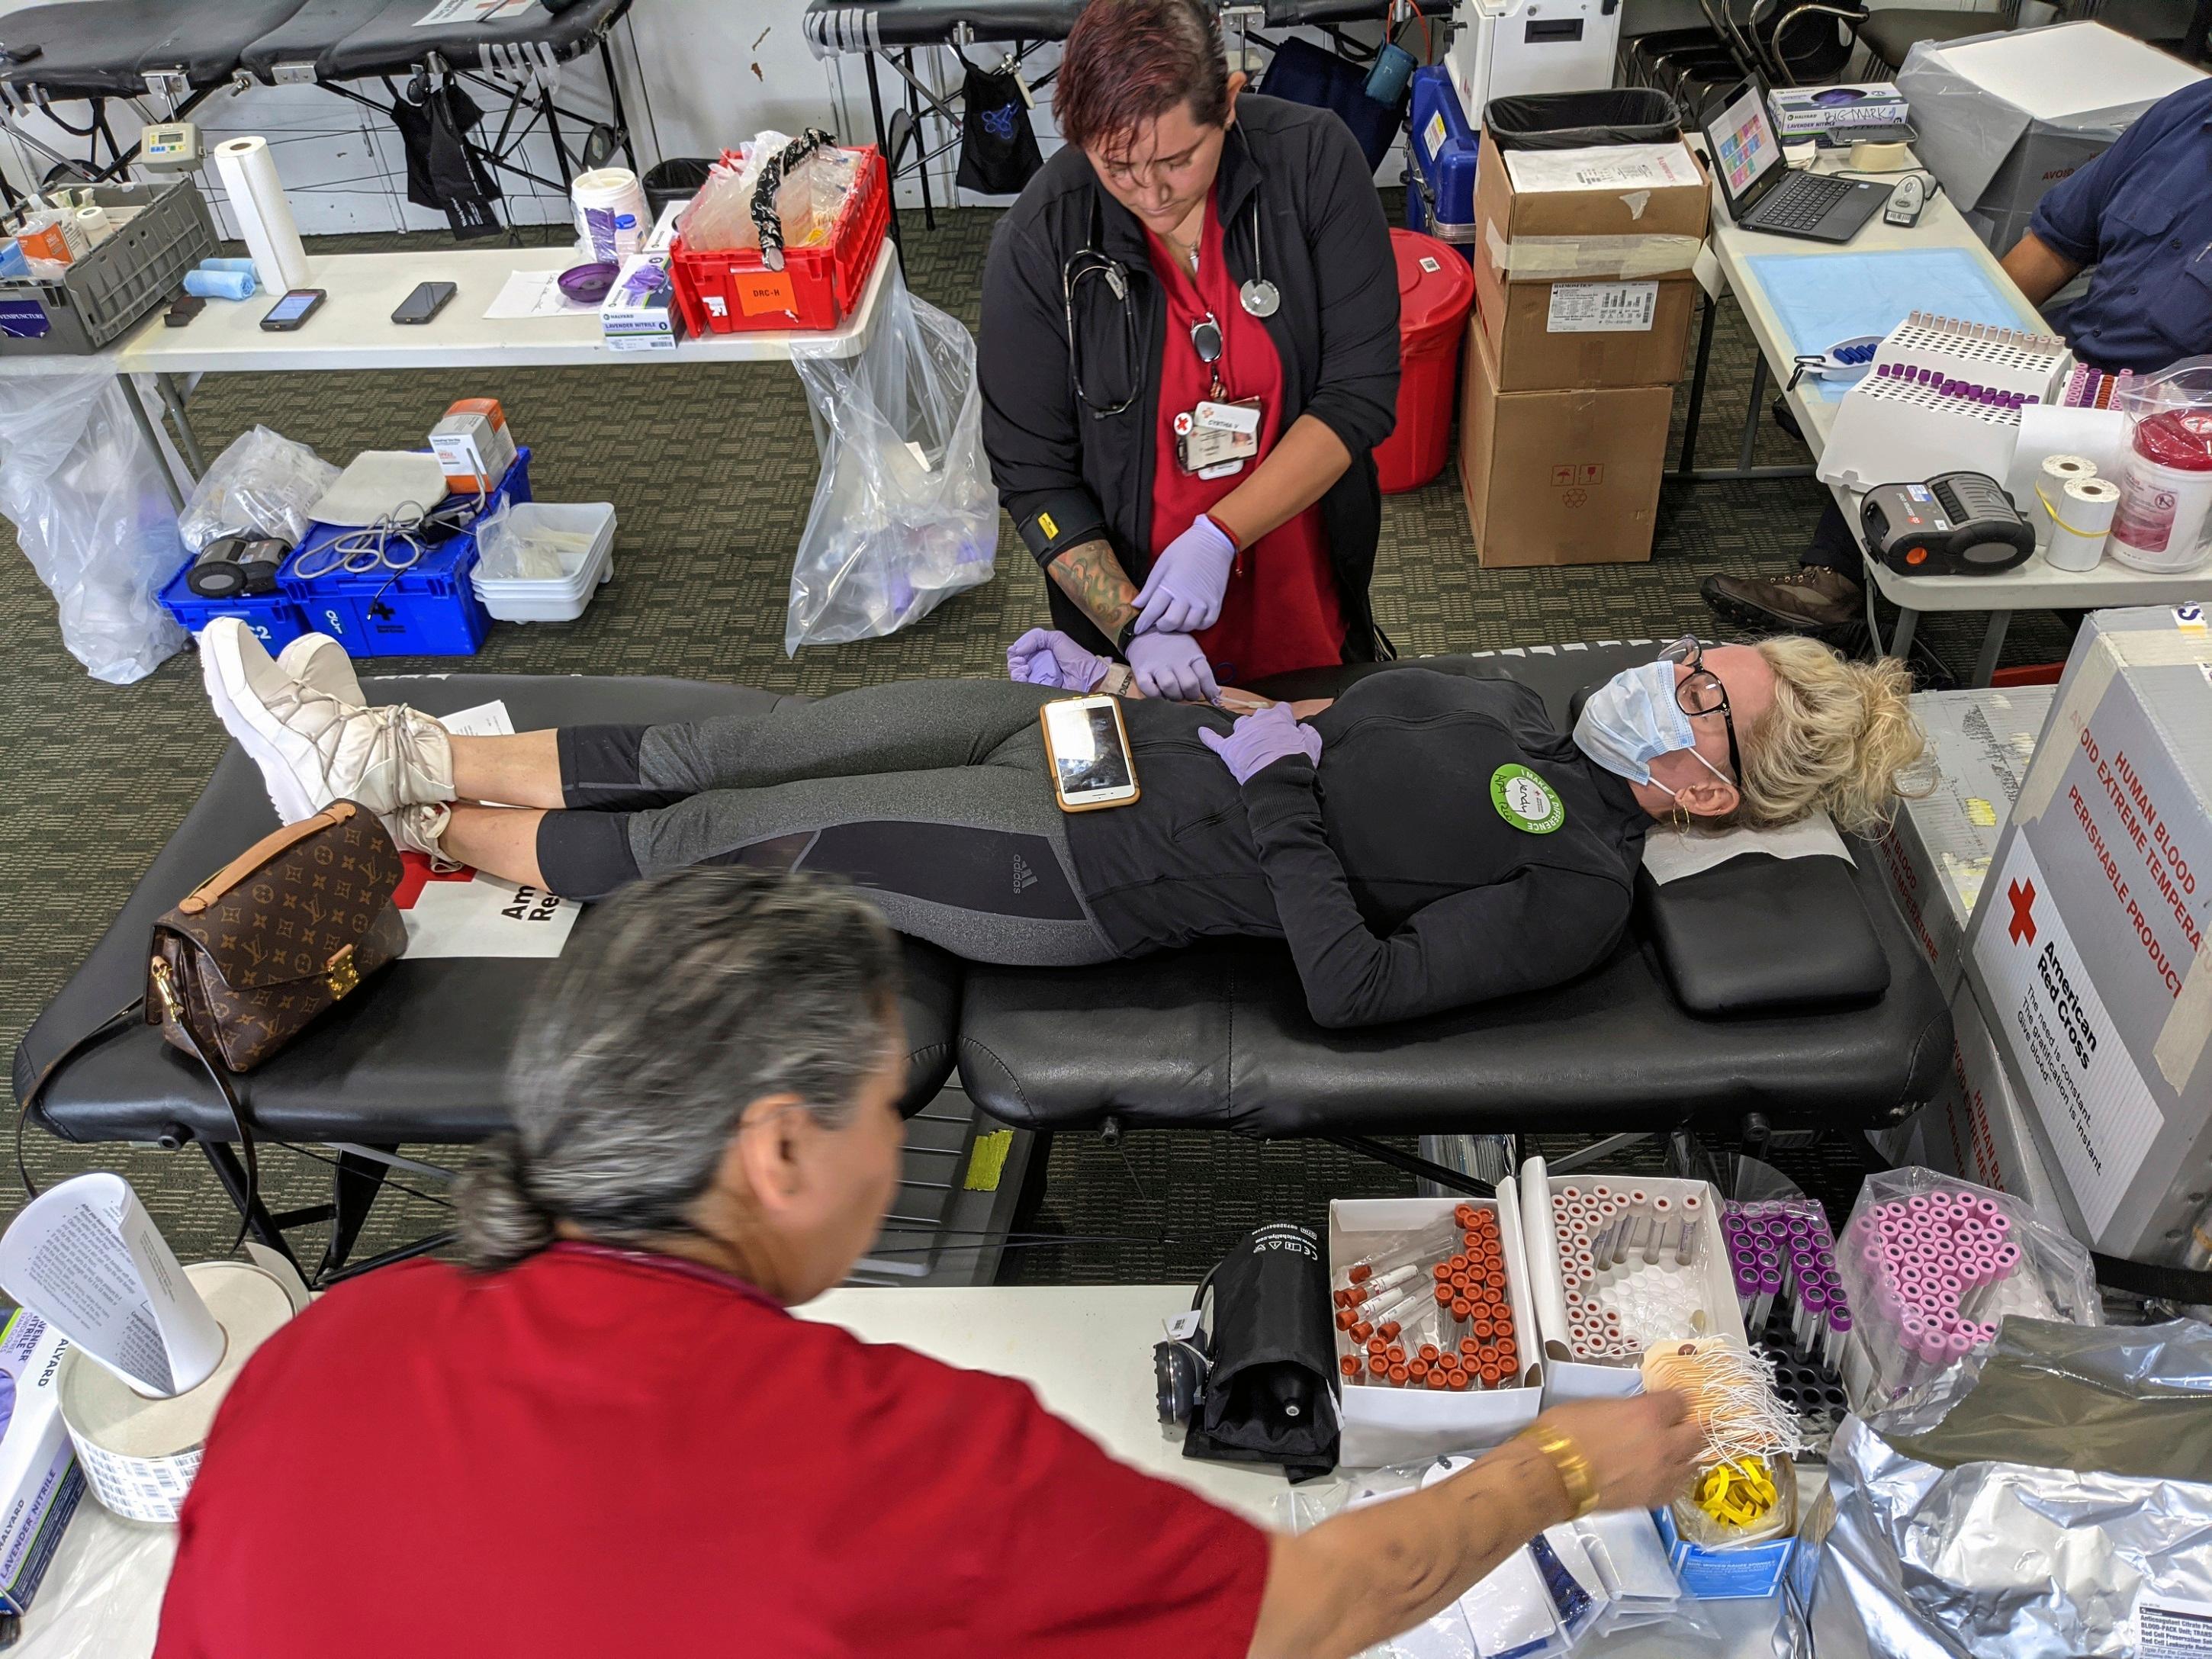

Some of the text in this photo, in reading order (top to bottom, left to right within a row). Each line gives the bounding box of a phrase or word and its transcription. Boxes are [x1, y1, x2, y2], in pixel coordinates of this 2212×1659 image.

[752, 288, 780, 297] DRC-H
[1526, 770, 1550, 793] MAKE
[1526, 801, 1561, 831] DIFFERENCE
[2096, 759, 2148, 854] EXTREME
[2114, 750, 2196, 895] HUMAN BLOOD
[1894, 840, 1917, 889] BLOOD
[2068, 783, 2130, 904] PERISHABLE
[1012, 854, 1023, 894] adidas
[527, 892, 561, 921] Re
[1890, 859, 1939, 965] TEMPERATURE
[2037, 953, 2090, 1070] Red Cross
[2043, 940, 2097, 1053] American
[2017, 1010, 2032, 1042] Give
[2027, 982, 2039, 1011] The
[2038, 1011, 2056, 1047] need
[2060, 1063, 2091, 1129] constant.
[2022, 995, 2034, 1025] The
[2032, 1027, 2069, 1104] gratification
[2075, 1120, 2102, 1177] instant.
[1973, 1088, 1995, 1162] HUMAN
[18, 1320, 47, 1362] VENDER
[37, 1338, 69, 1388] ALYARD
[0, 1516, 34, 1580] LAVENDER
[31, 1468, 56, 1515] NITRILE
[2140, 1615, 2181, 1626] Anticoagulant
[2181, 1621, 2201, 1629] Citrate
[2141, 1622, 2177, 1632] BLOOD-PACK
[2165, 1633, 2201, 1644] Preservation
[2165, 1641, 2194, 1650] Leukocyte
